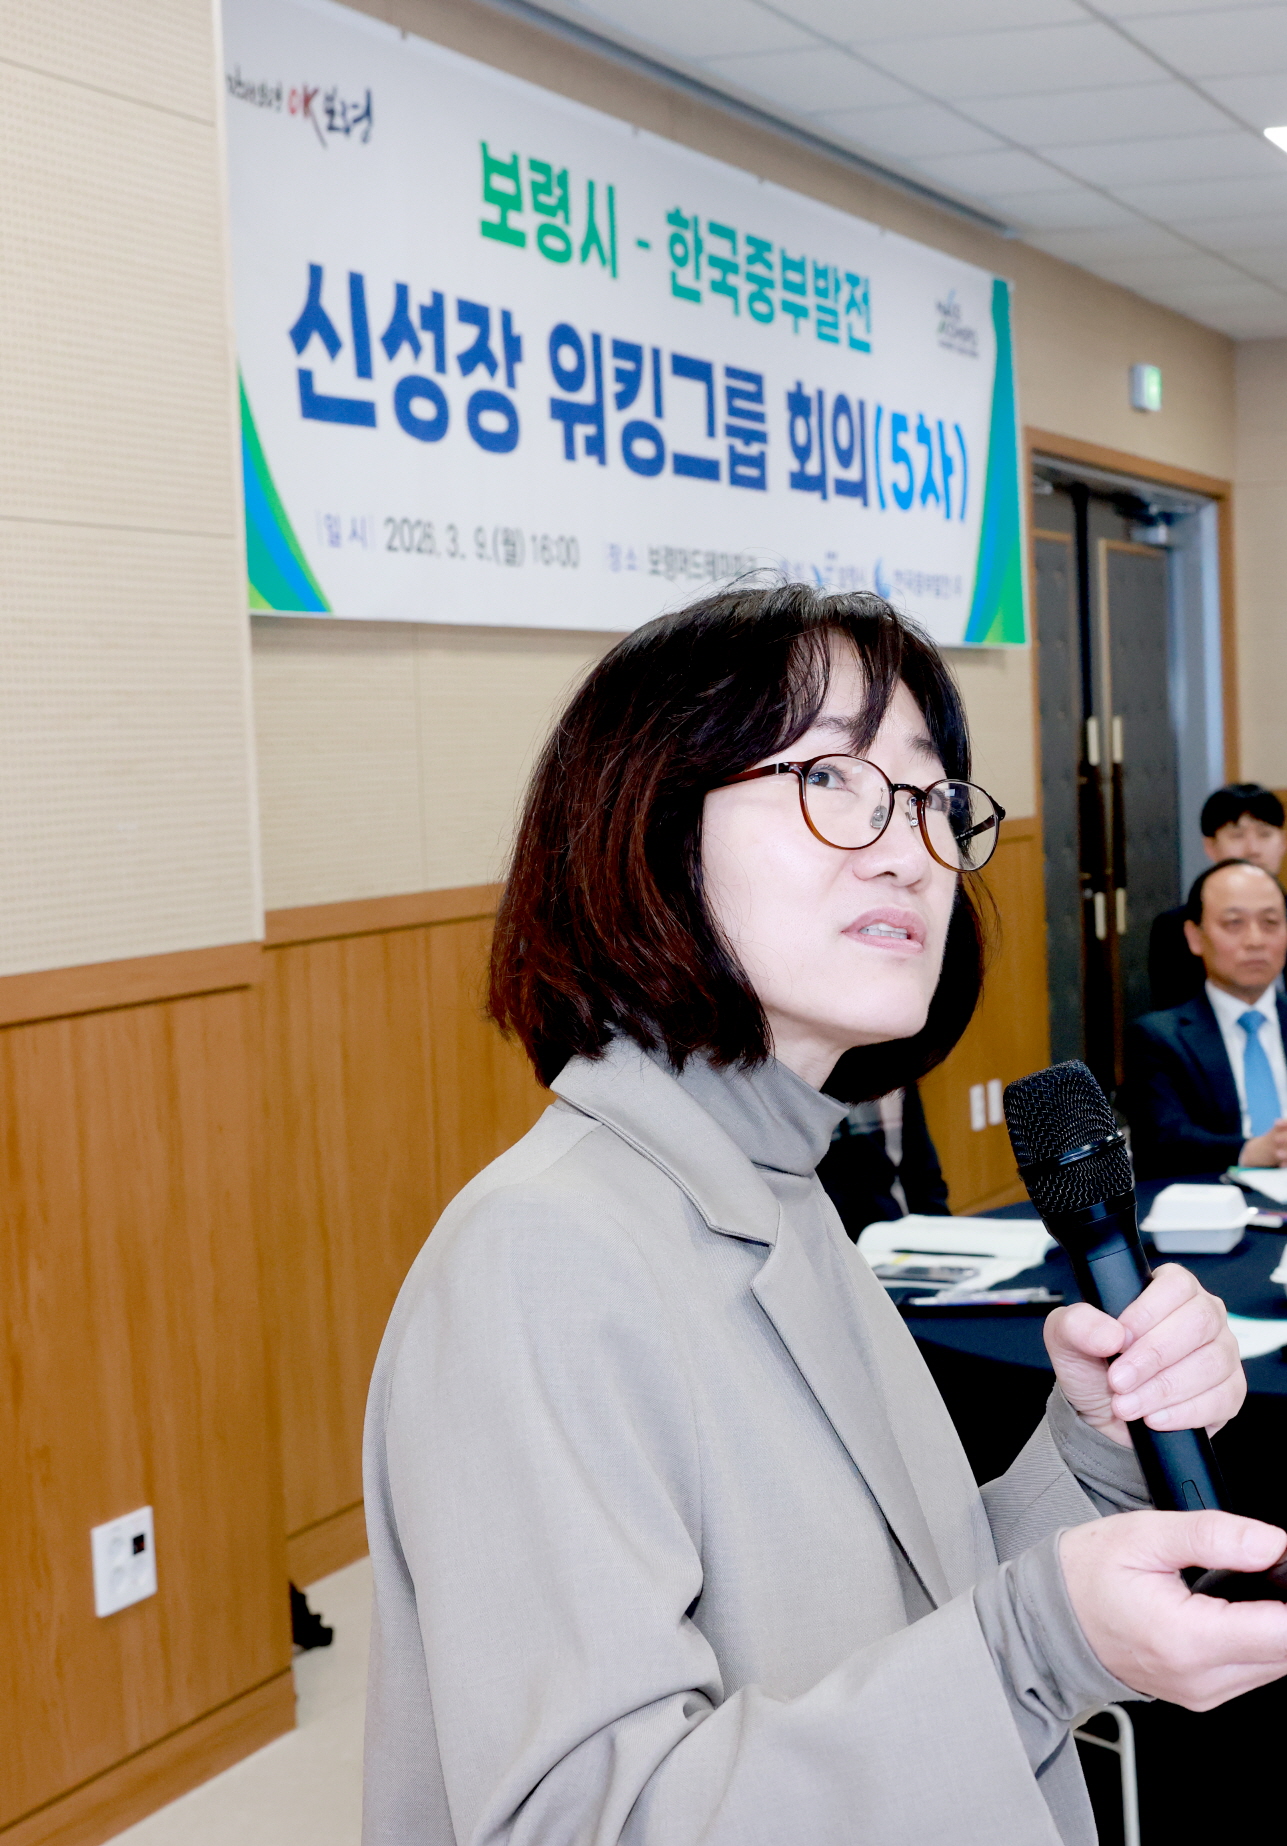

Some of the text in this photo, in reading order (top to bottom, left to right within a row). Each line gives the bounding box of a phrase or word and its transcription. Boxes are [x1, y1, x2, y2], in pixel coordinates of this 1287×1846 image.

[479, 140, 620, 281] 보령시
[665, 205, 874, 356] 한국중부발전
[288, 261, 970, 524] 신성장 워킹그룹 회의(5차)
